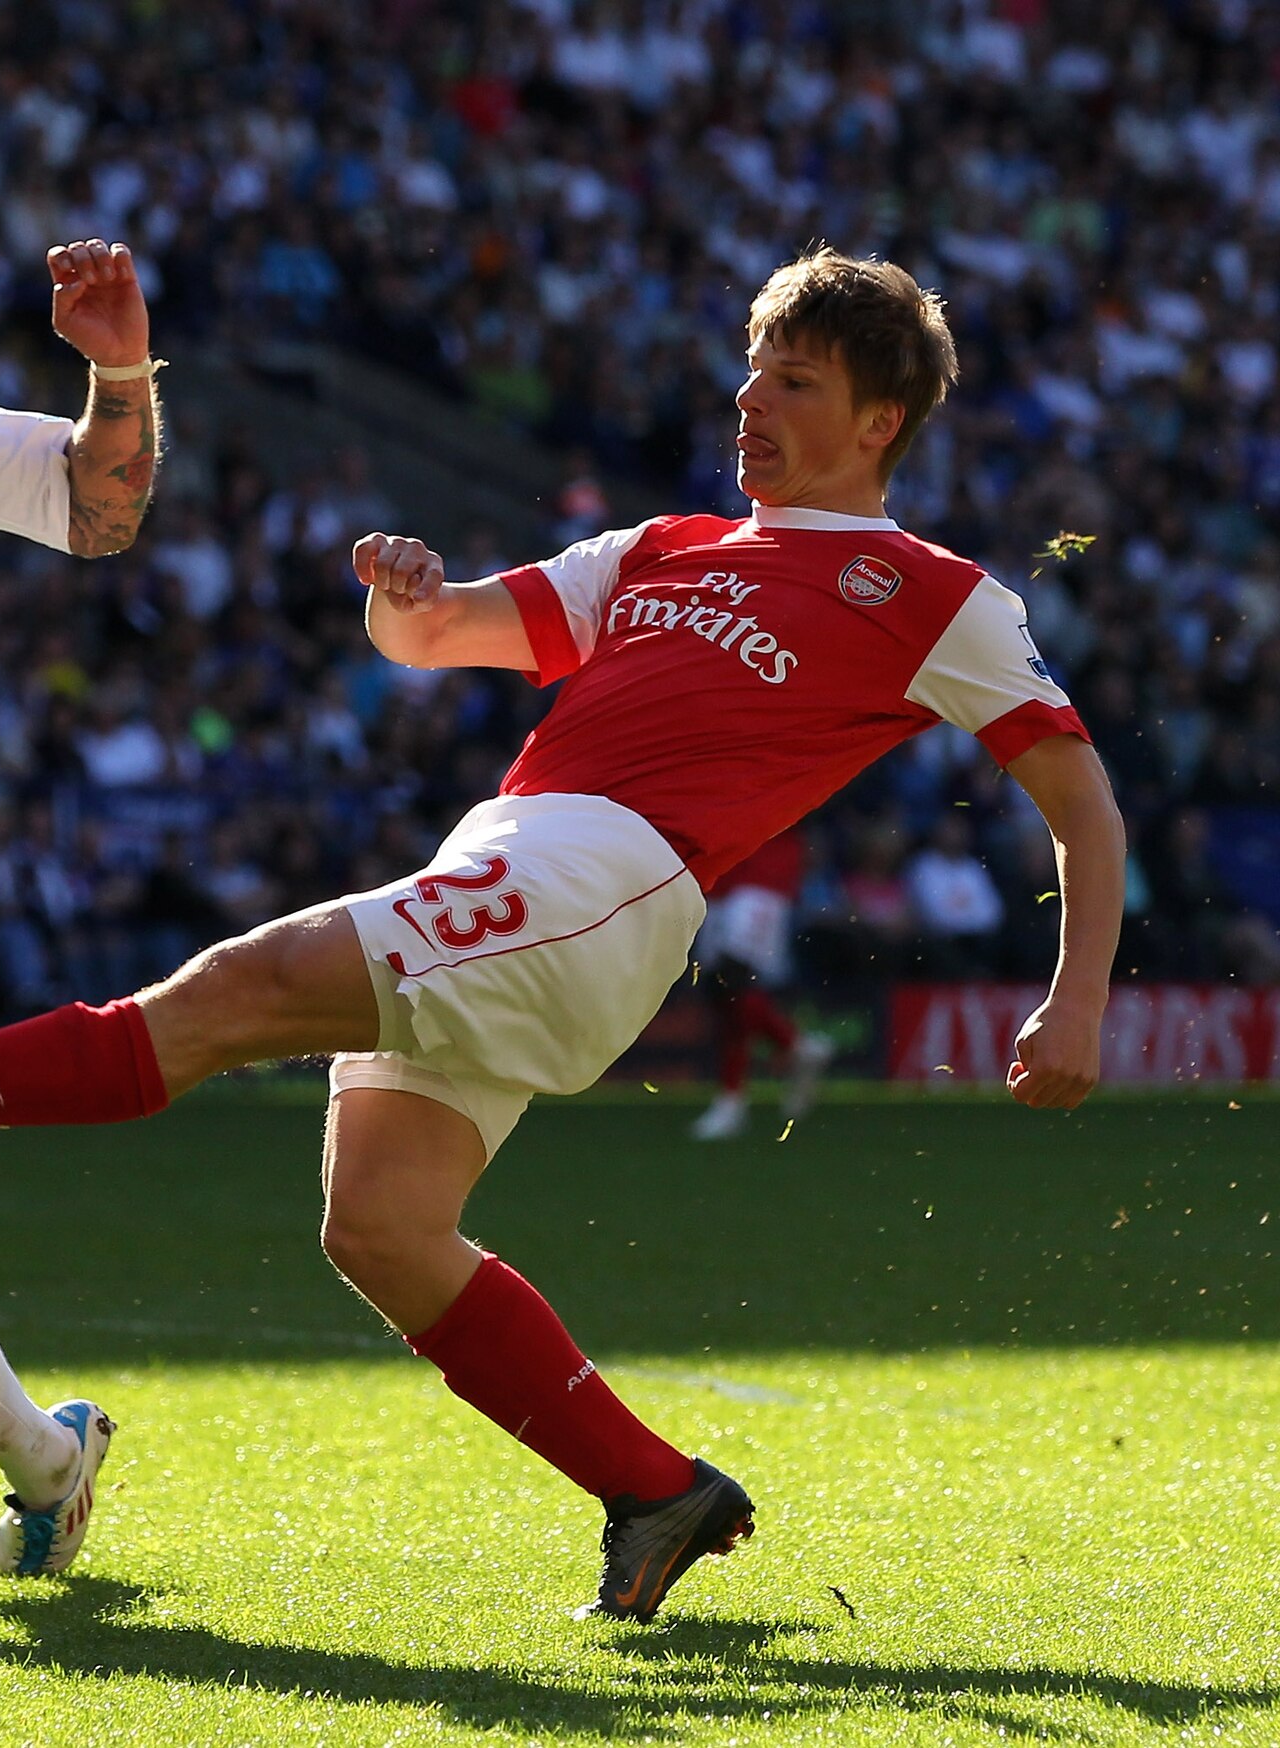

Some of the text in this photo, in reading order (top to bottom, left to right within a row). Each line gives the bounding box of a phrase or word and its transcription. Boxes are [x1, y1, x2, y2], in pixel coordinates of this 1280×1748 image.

[700, 571, 761, 605] Fly
[856, 563, 892, 588] Arsenal
[607, 592, 799, 684] Emirates
[414, 854, 528, 950] 23
